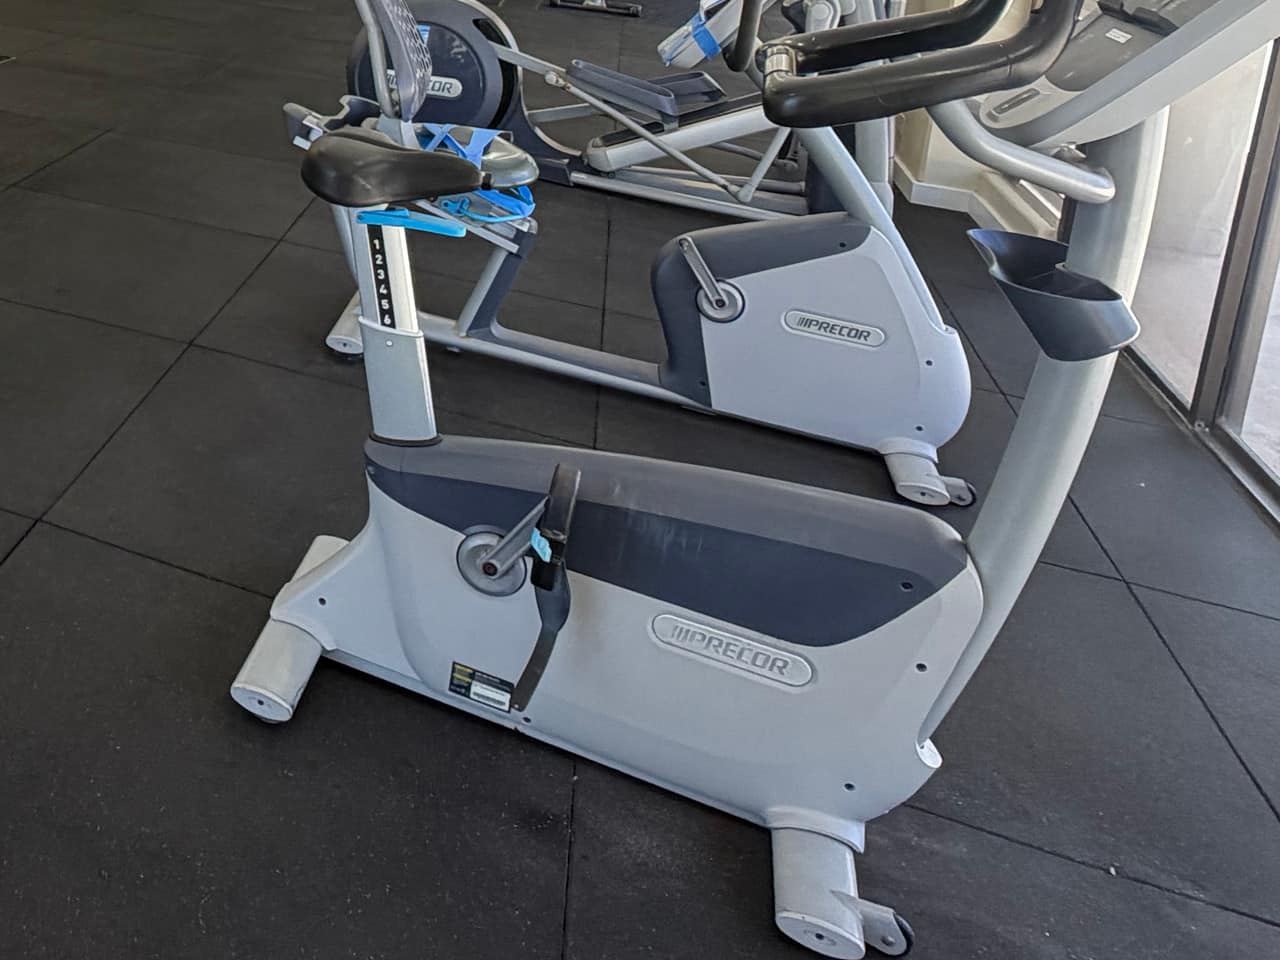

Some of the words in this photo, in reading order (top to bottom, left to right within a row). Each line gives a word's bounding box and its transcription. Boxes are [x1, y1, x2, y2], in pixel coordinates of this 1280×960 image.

[373, 239, 380, 250] 1
[375, 254, 383, 265] 2
[377, 269, 385, 280] 3
[379, 284, 387, 295] 4
[381, 299, 389, 310] 5
[383, 314, 392, 325] 6
[806, 317, 871, 341] PRECOR
[686, 627, 790, 676] PRECOR
